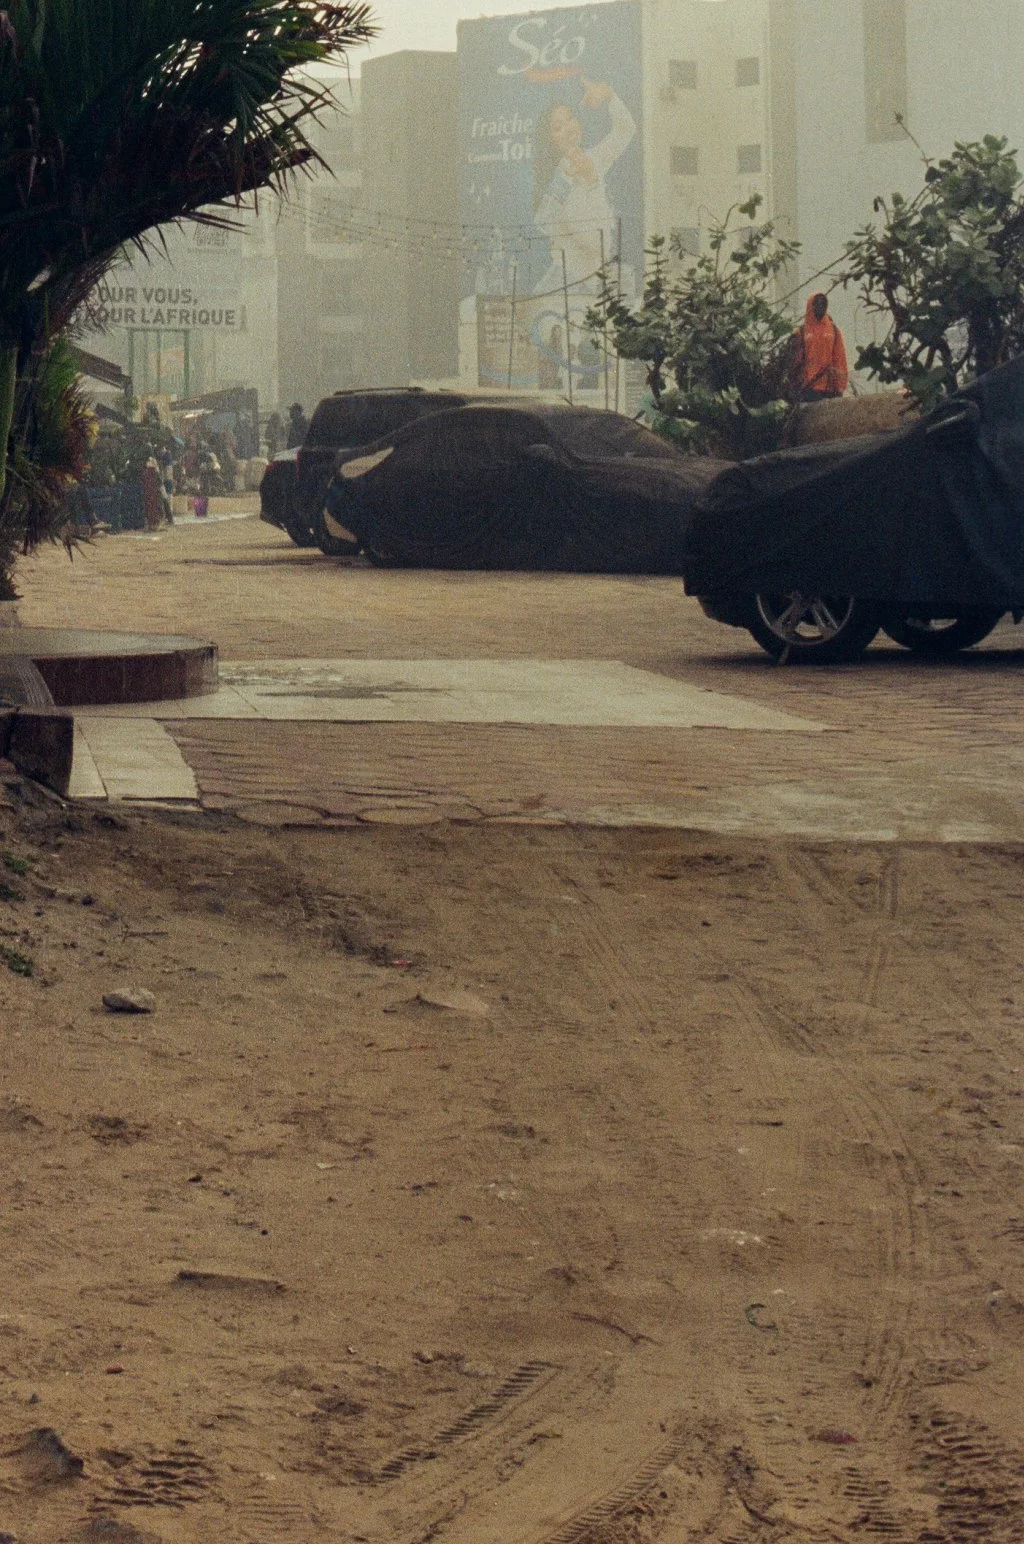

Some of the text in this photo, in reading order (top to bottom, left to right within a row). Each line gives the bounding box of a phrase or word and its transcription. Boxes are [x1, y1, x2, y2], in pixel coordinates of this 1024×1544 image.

[499, 17, 586, 75] Séo
[500, 136, 532, 162] Toi
[142, 287, 198, 305] VOUS,
[85, 307, 236, 325] OUR L'AFRIQUE
